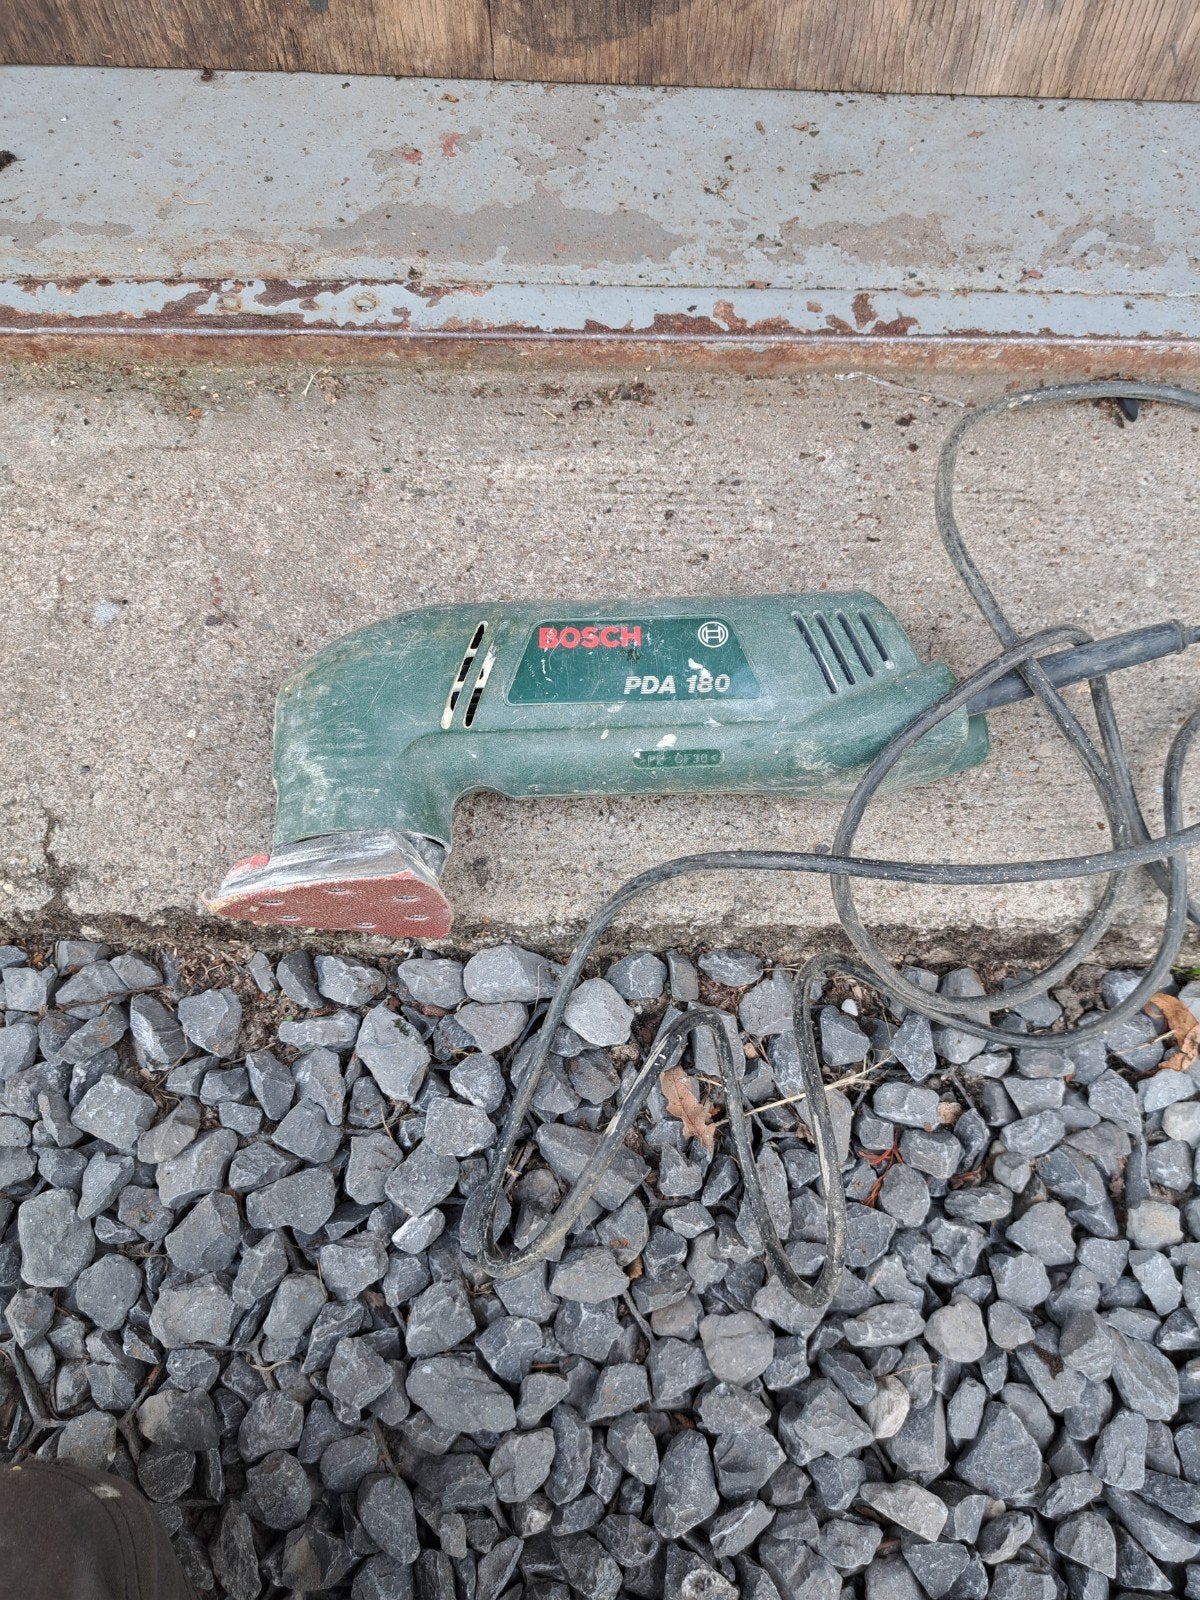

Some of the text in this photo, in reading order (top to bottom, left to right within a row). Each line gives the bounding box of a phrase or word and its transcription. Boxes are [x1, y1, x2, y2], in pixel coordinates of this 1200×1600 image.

[538, 626, 642, 649] BOSCH
[623, 674, 731, 695] PDA 180
